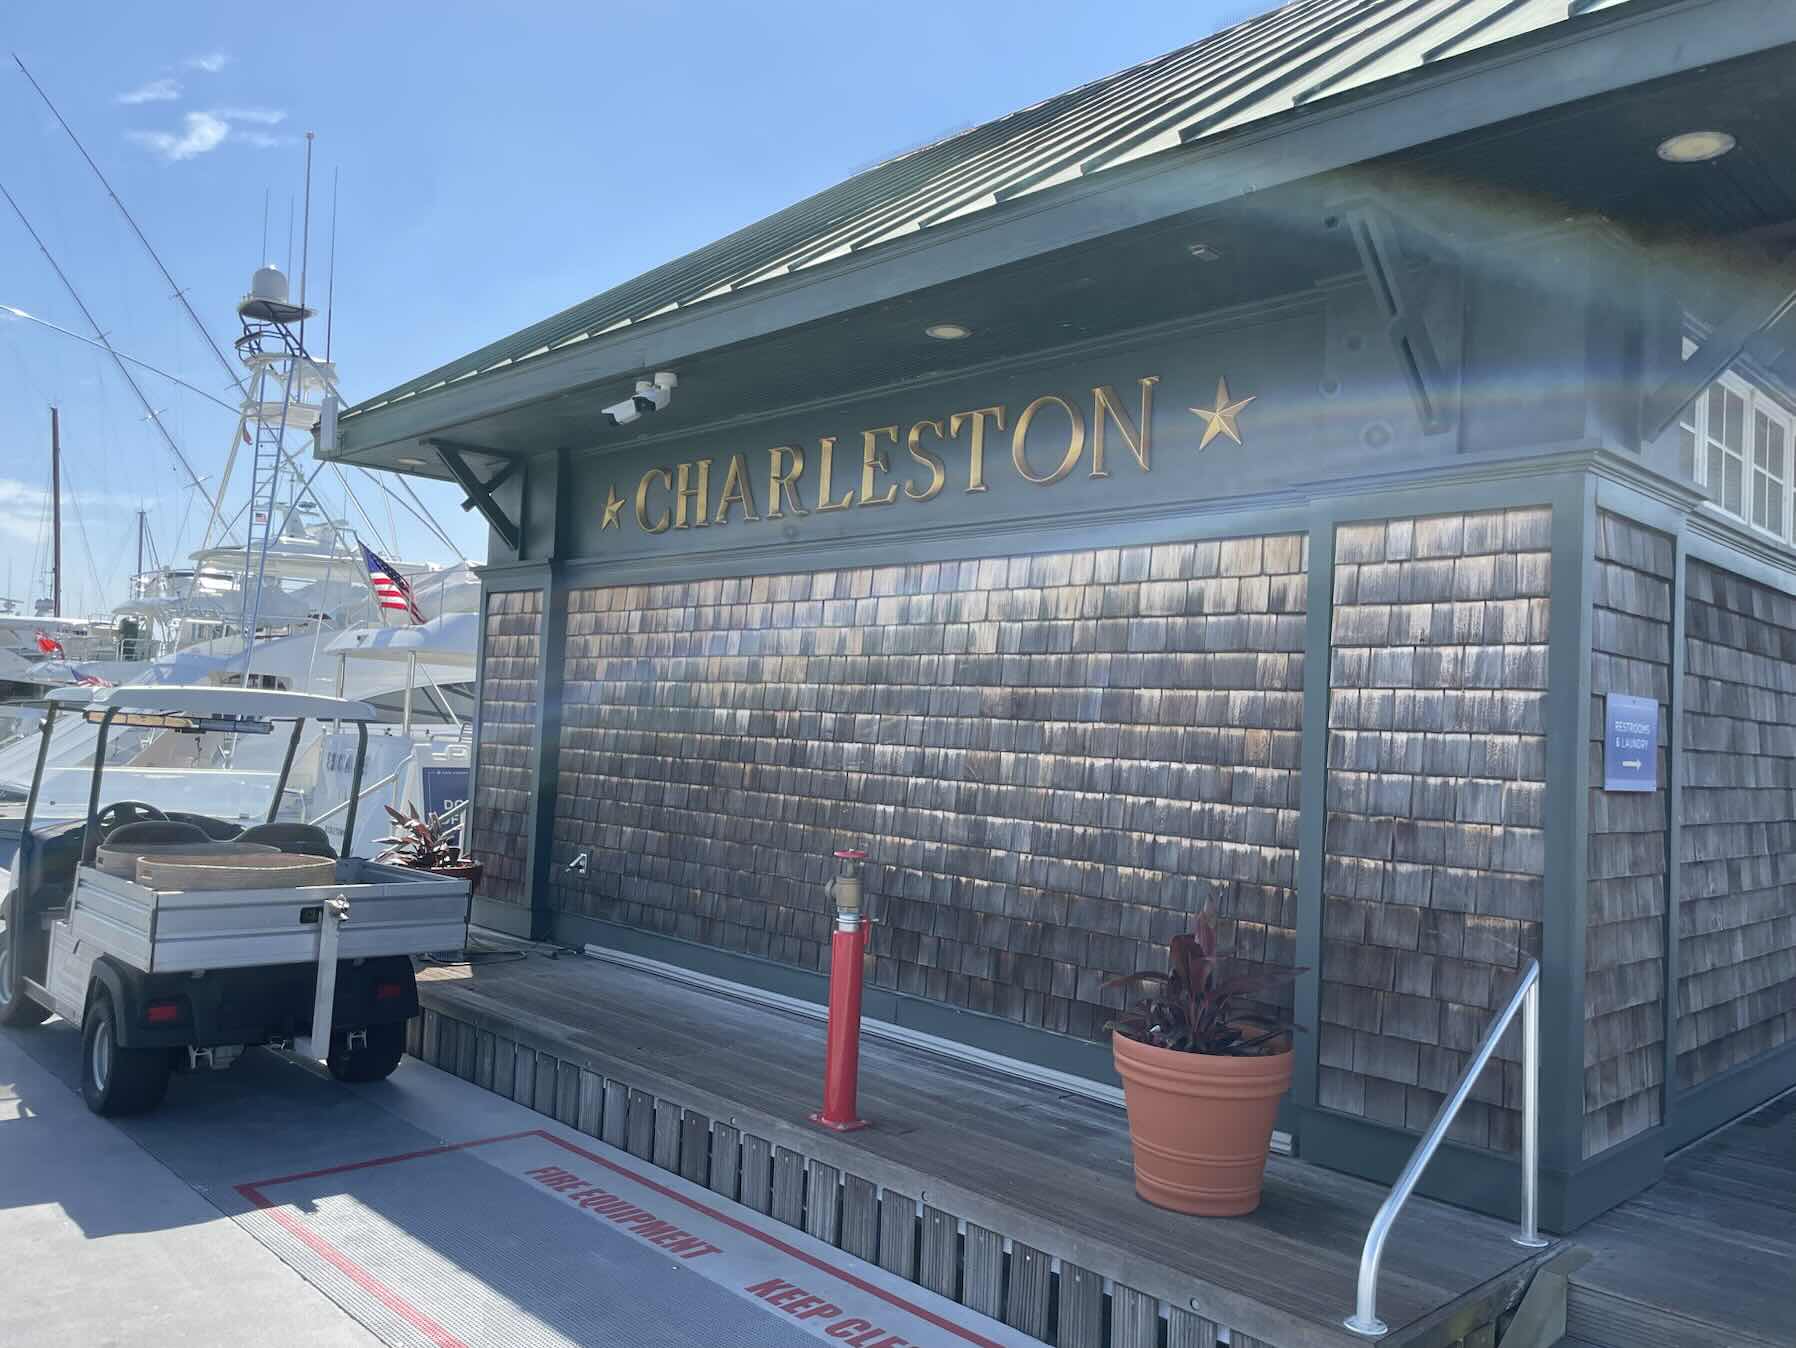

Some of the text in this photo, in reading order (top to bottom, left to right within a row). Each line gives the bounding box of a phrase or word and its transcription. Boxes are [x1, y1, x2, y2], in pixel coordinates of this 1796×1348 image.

[635, 375, 1163, 534] CHARLESTON
[525, 1165, 723, 1260] FIRE EQUIPMENT
[744, 1278, 918, 1348] KEEP CLE
